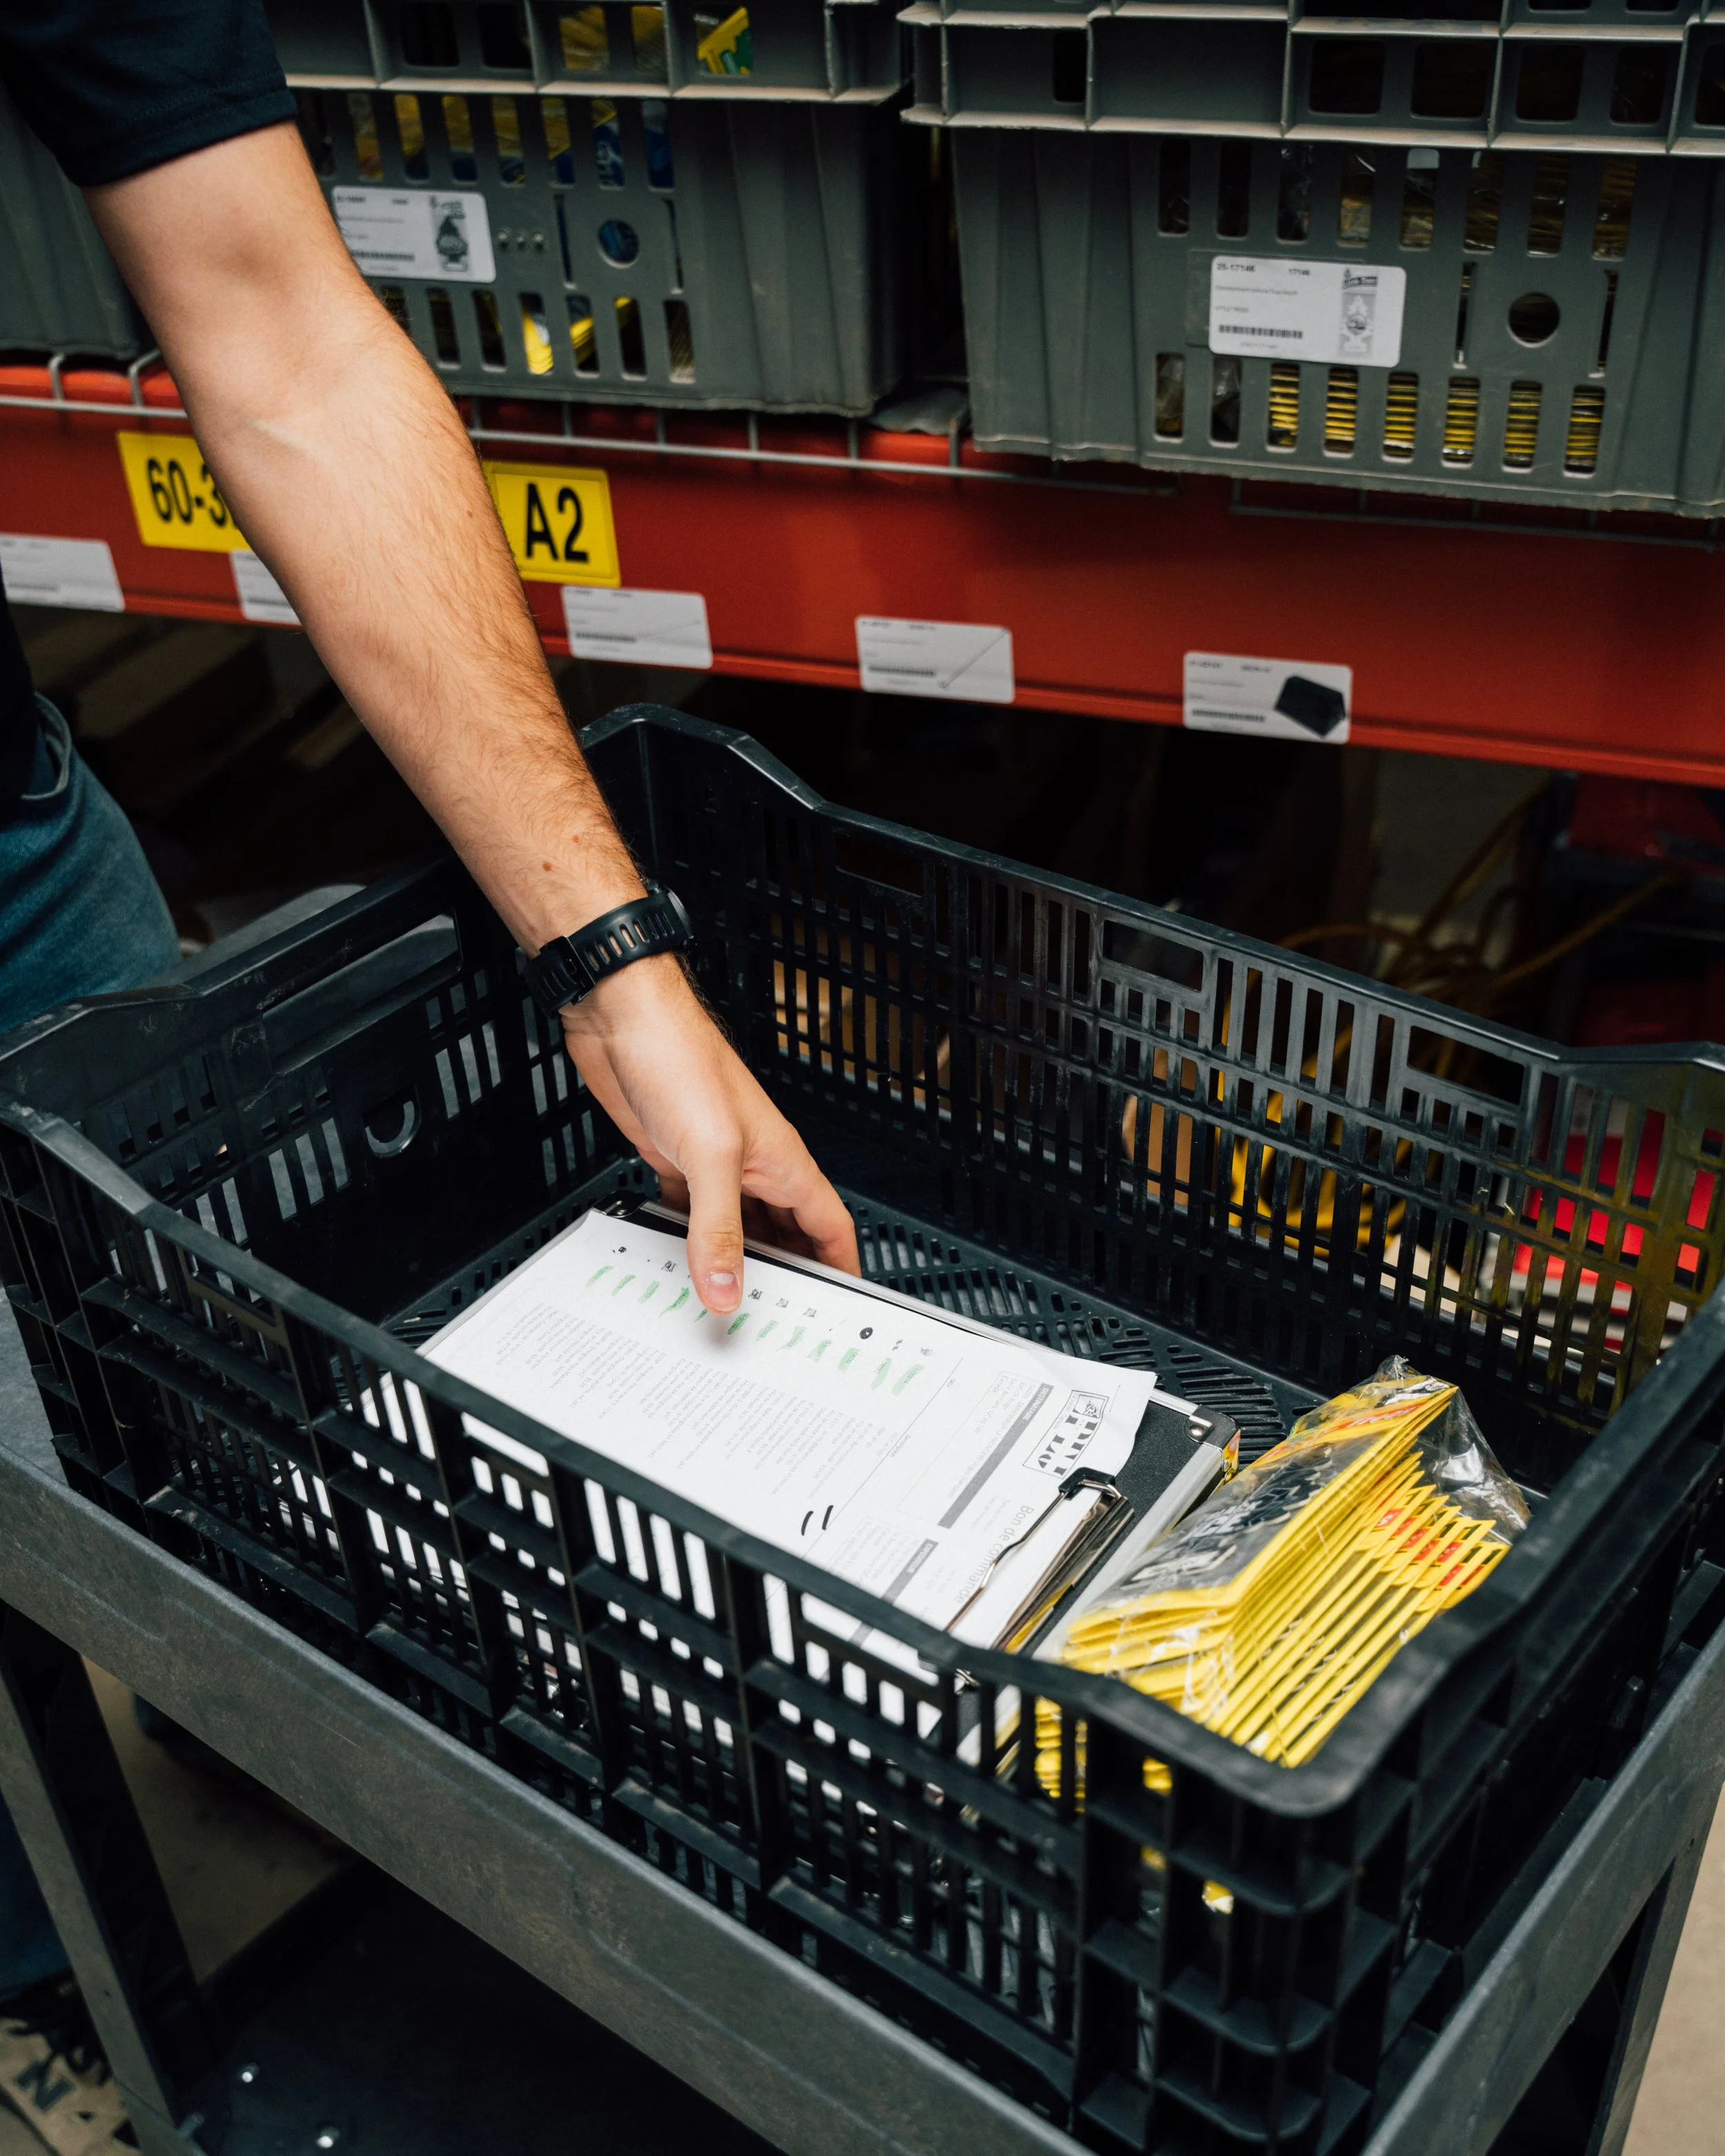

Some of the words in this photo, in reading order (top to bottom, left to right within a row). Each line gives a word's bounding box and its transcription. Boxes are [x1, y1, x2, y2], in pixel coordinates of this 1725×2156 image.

[526, 482, 589, 565] A2
[1023, 1387, 1049, 1421] DESTINATAIRE
[887, 1434, 911, 1458] Description
[1011, 1505, 1034, 1525] Bon
[1000, 1527, 1016, 1541] de
[954, 1543, 1003, 1604] commande
